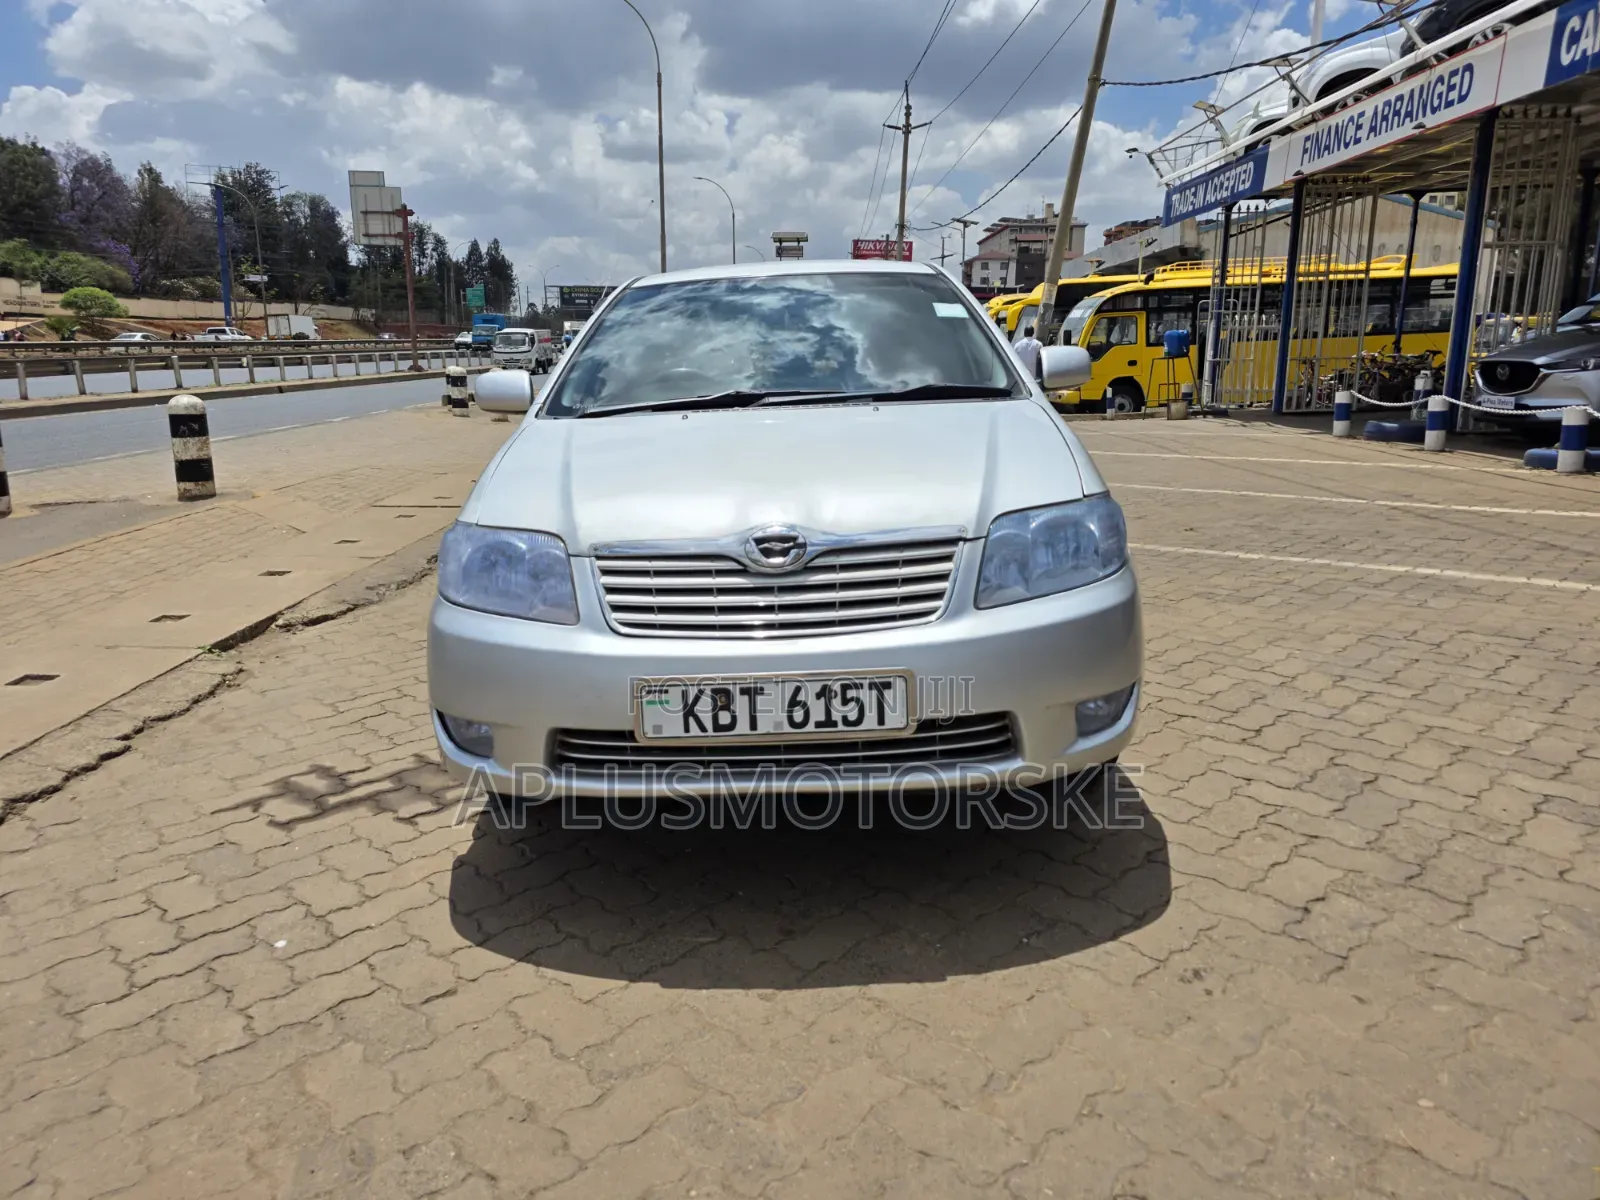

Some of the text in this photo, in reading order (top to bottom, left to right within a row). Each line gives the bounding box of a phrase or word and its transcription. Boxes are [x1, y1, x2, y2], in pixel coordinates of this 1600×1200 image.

[1300, 62, 1474, 167] FINANCE ARRANGED
[1170, 161, 1254, 218] TRADE-IN ACCEPTED
[681, 681, 892, 733] KBT 615T
